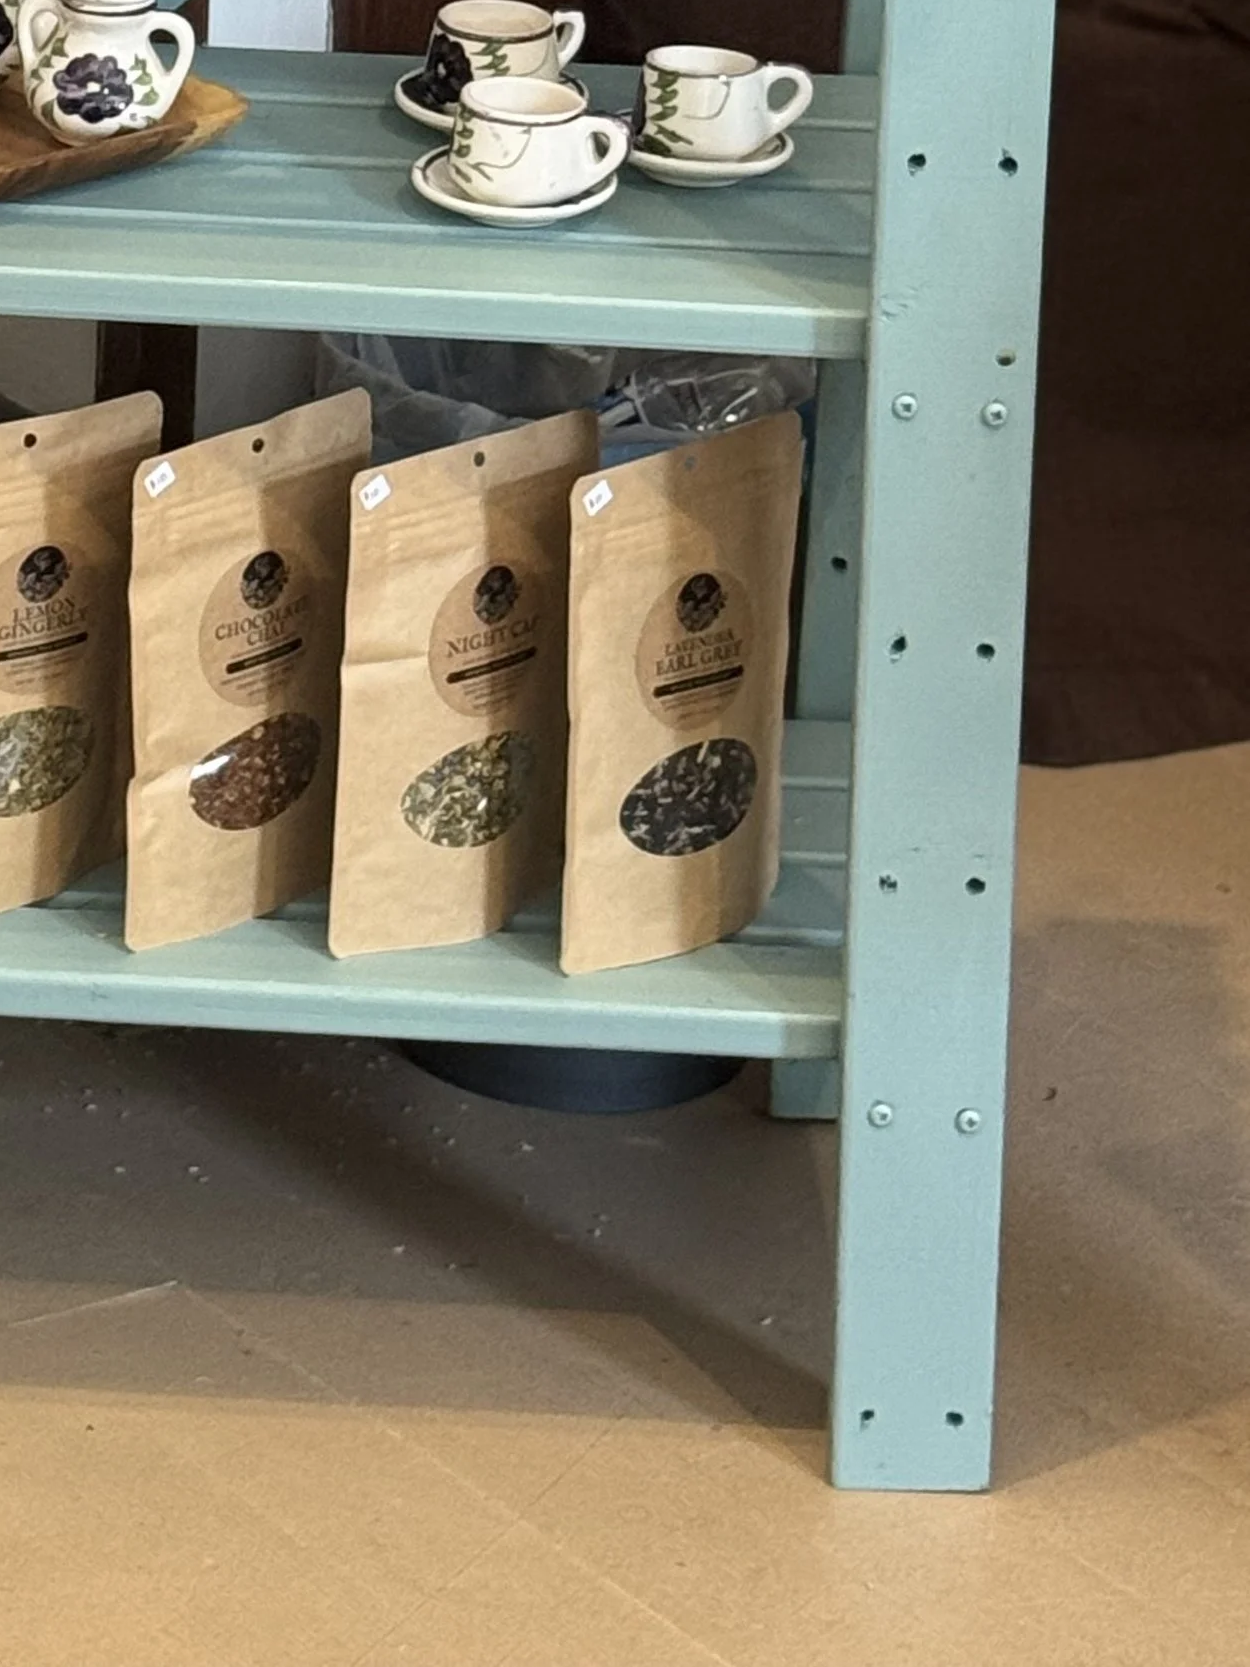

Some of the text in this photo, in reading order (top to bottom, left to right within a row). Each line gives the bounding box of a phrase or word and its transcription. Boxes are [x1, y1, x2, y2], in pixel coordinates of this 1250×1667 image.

[13, 597, 76, 624] LEMON
[246, 620, 286, 646] CHAI
[445, 625, 508, 658] NIGHT
[654, 639, 744, 677] EARL GREY
